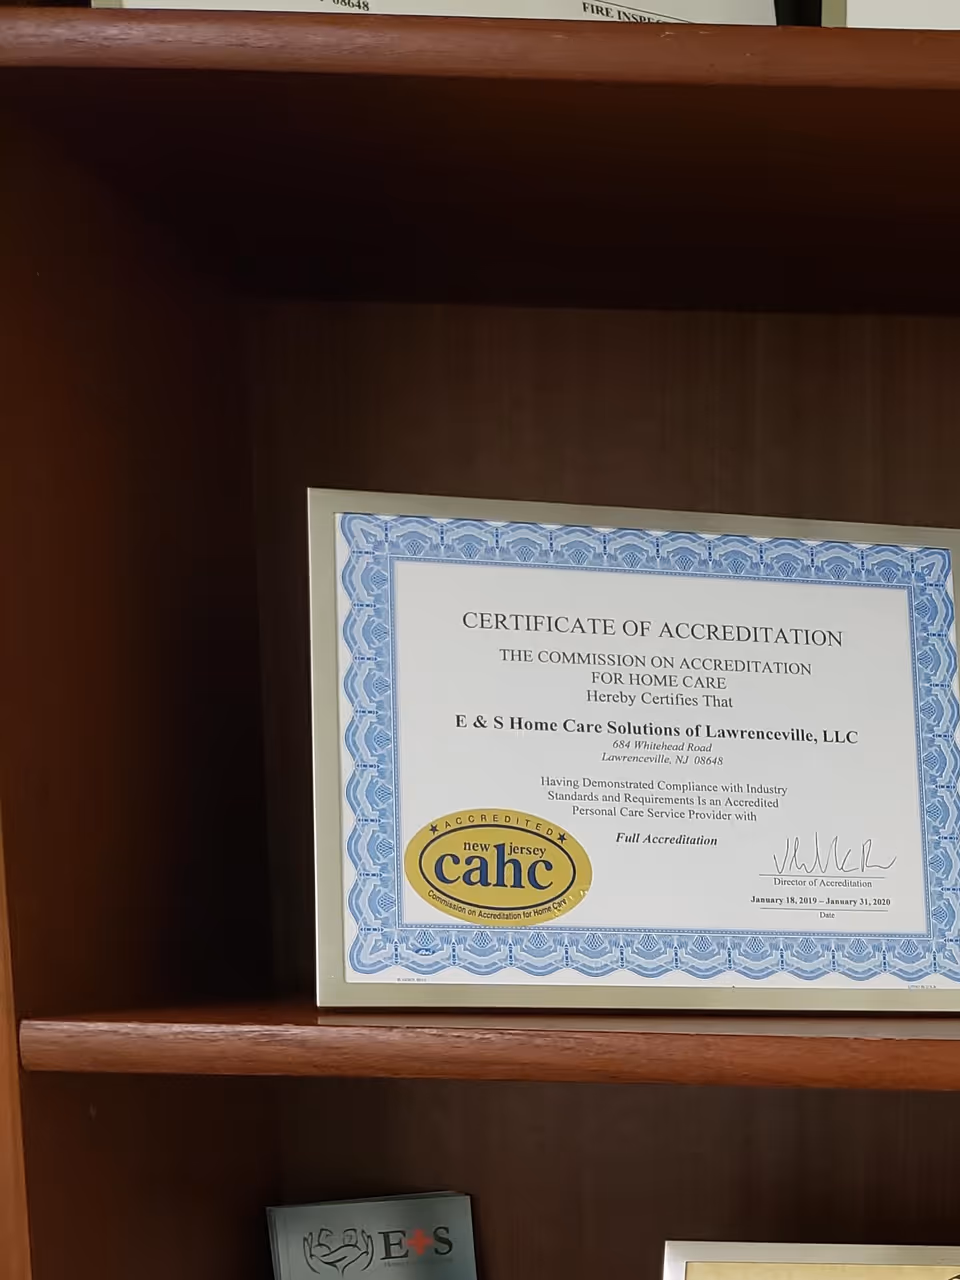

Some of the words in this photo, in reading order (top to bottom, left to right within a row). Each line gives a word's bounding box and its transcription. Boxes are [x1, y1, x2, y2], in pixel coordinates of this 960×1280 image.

[582, 2, 614, 18] FIRE
[462, 611, 615, 635] CERTIFICATE
[622, 619, 651, 636] OF
[658, 621, 842, 646] ACCREDITATION
[498, 648, 533, 662] THE
[537, 650, 645, 667] COMMISSION
[650, 655, 674, 668] ON
[679, 657, 811, 675] ACCREDITATION
[591, 671, 624, 684] FOR
[628, 673, 678, 687] HOME
[682, 675, 726, 689] CARE
[455, 714, 466, 727] E
[472, 714, 487, 728] &
[493, 715, 503, 729] S
[509, 716, 557, 731] Home
[562, 718, 601, 733] Care
[607, 720, 680, 736] Solutions
[685, 724, 701, 737] of
[705, 724, 817, 744] Lawrenceville,
[822, 729, 857, 743] LLC
[612, 739, 630, 749] 684
[634, 740, 685, 751] Whitehead
[686, 742, 712, 752] Road
[601, 752, 671, 764] Lawrenceville,
[674, 754, 689, 764] NJ
[693, 755, 723, 766] 08648
[615, 832, 640, 843] Full
[642, 833, 717, 845] Accreditation
[463, 843, 491, 852] new
[507, 844, 547, 859] jersey
[433, 843, 553, 891] cahc
[772, 876, 807, 888] Director
[808, 877, 818, 888] of
[818, 877, 872, 887] Accreditation
